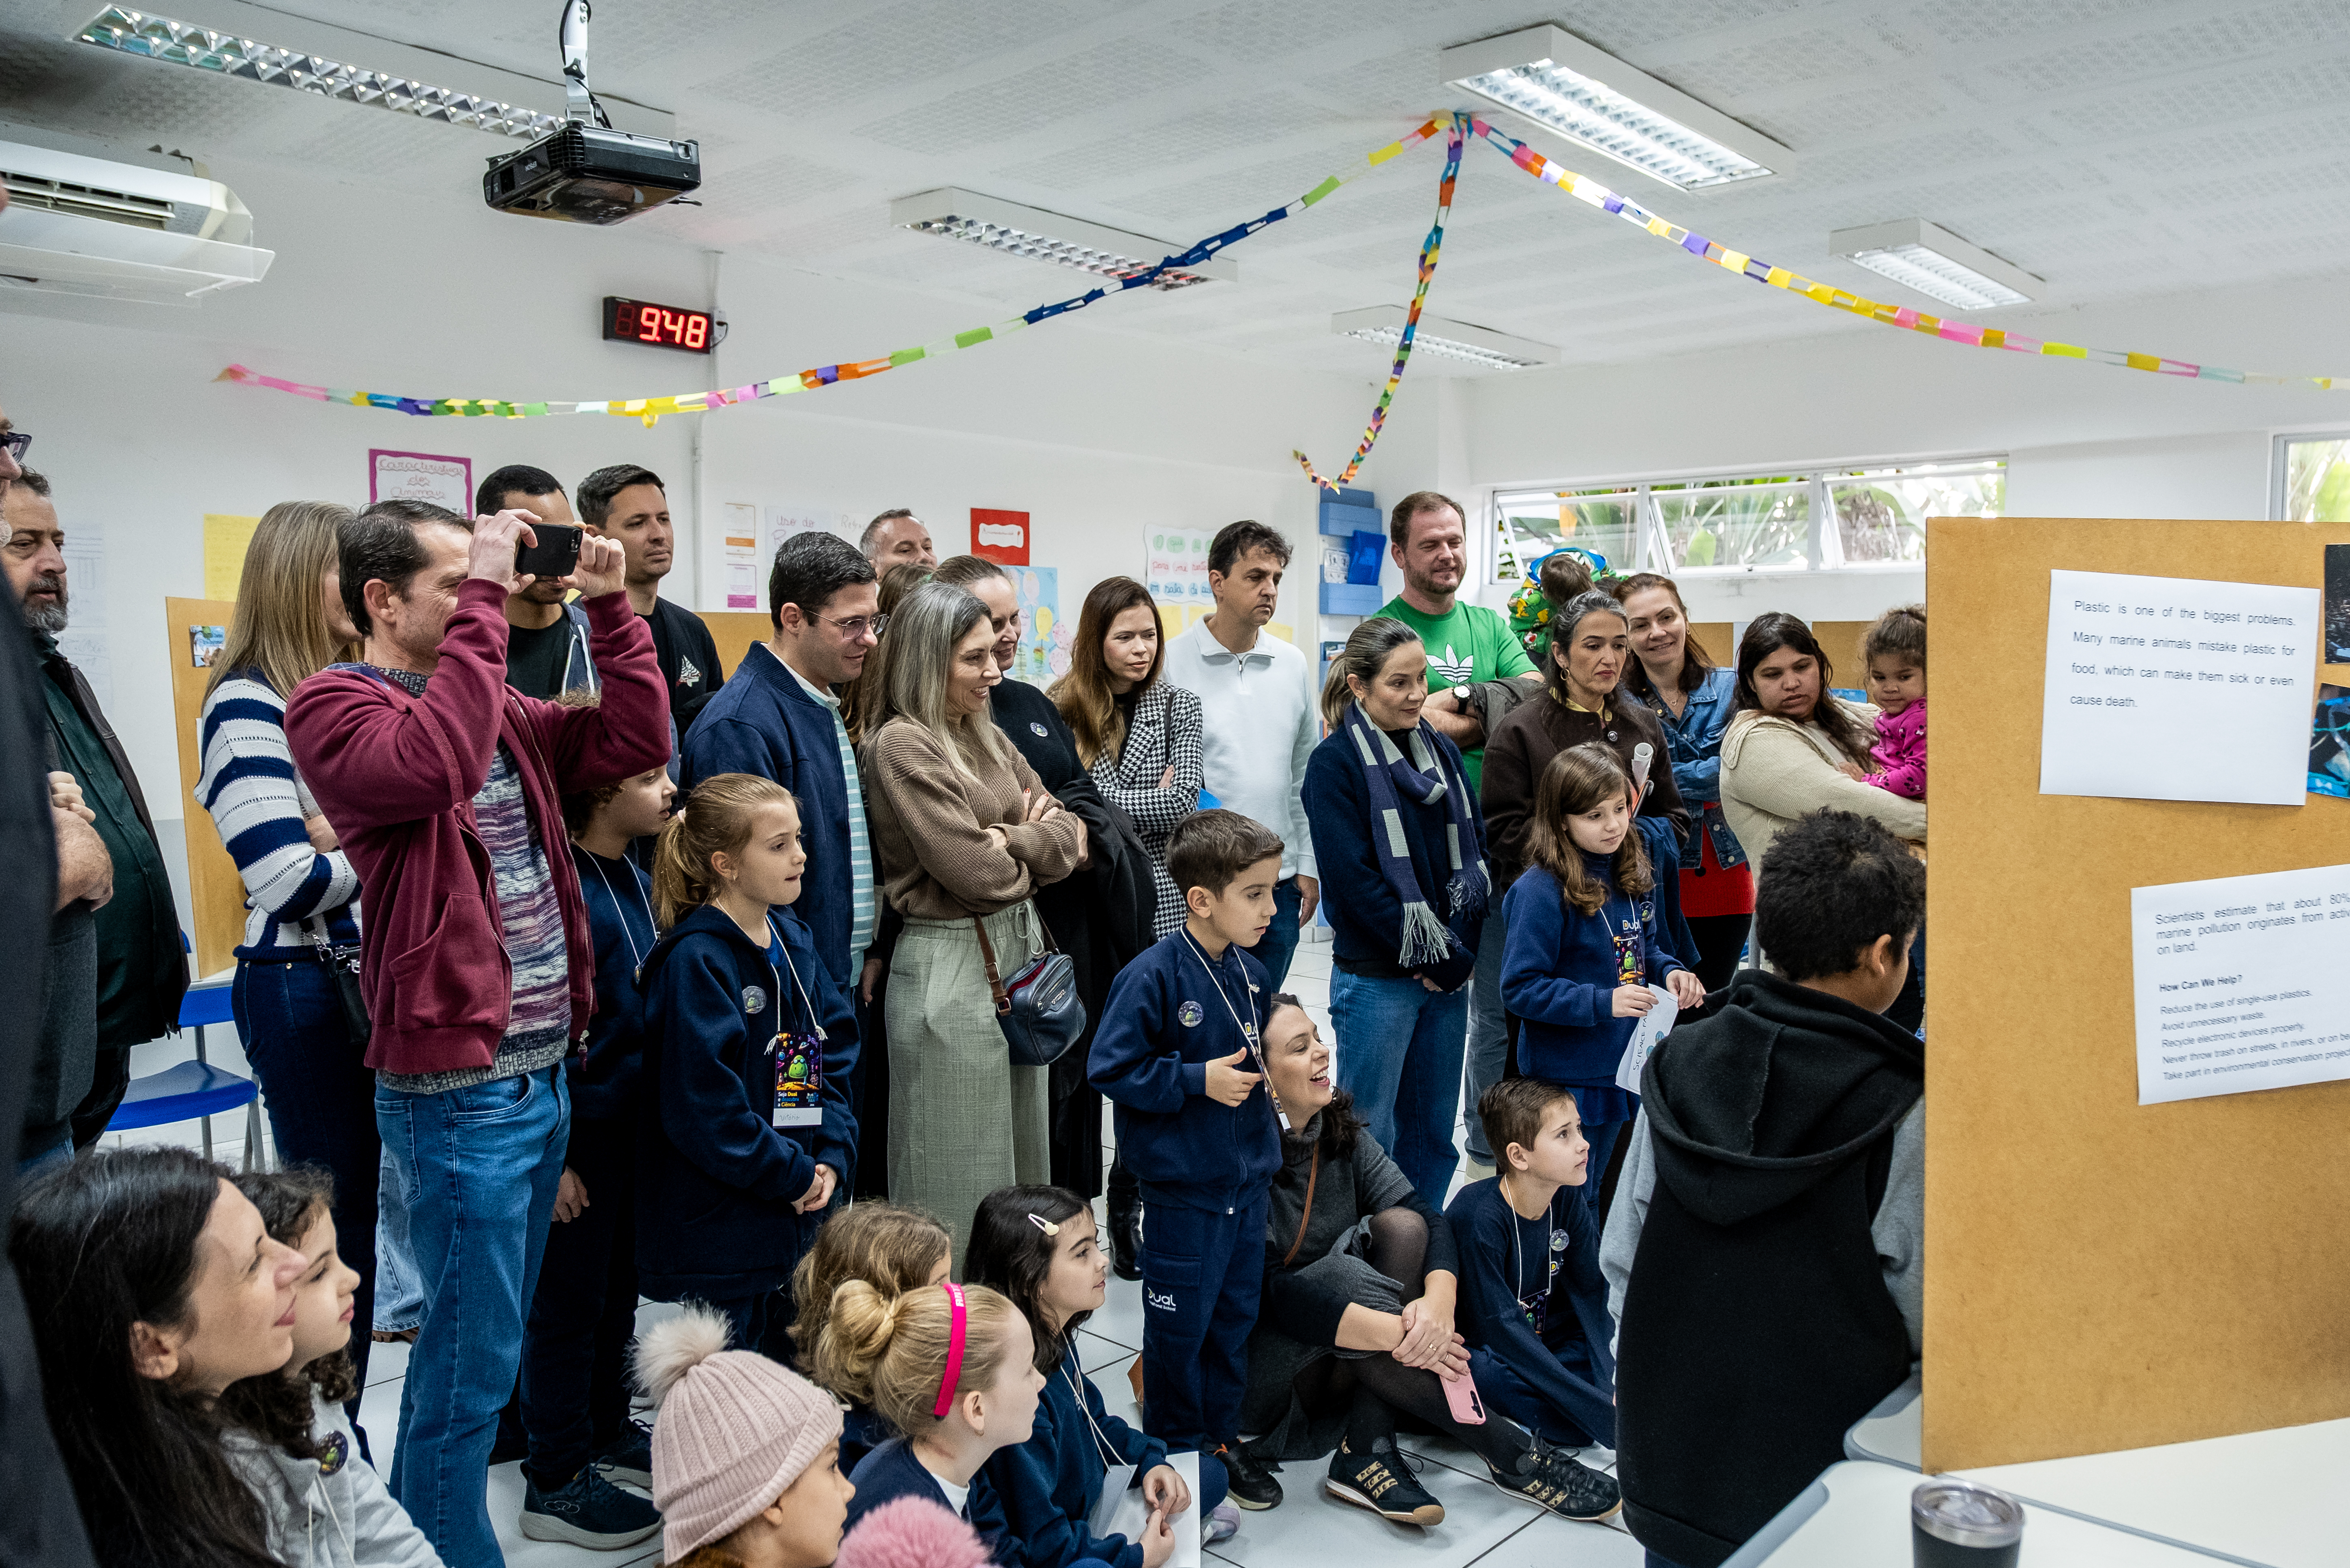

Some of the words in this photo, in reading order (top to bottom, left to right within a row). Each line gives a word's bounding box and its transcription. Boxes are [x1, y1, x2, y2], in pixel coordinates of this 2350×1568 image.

[2075, 600, 2110, 613] Plastic
[2118, 604, 2127, 614] is
[2135, 606, 2154, 616] one
[2162, 606, 2173, 617] of
[2180, 608, 2196, 619] the
[2204, 610, 2241, 624] biggest
[2247, 613, 2296, 626] problems.
[2073, 631, 2103, 646] Many
[2110, 634, 2146, 647] marine
[2152, 637, 2192, 650] animals
[2198, 640, 2237, 653] mistake
[2243, 643, 2276, 656] plastic
[2281, 645, 2296, 656] for
[2071, 663, 2098, 676] food,
[2104, 664, 2134, 677] which
[2140, 668, 2159, 678] can
[2164, 668, 2193, 681] make
[2198, 670, 2224, 682] them
[2229, 672, 2249, 684] sick
[2254, 675, 2265, 685] or
[2270, 676, 2294, 686] even
[2070, 695, 2102, 706] cause
[2105, 695, 2138, 708] death.
[2155, 911, 2205, 924] Scientists
[2214, 904, 2258, 918] estimate
[2266, 900, 2286, 912] that
[2294, 897, 2322, 908] about
[2156, 927, 2191, 940] marine
[2198, 922, 2241, 937] pollution
[2247, 916, 2296, 930] originates
[2302, 912, 2324, 923] from
[2157, 945, 2170, 955] on
[2173, 941, 2198, 953] land.
[2159, 983, 2179, 992] How
[2181, 981, 2199, 990] Can
[2200, 979, 2215, 987] We
[2217, 974, 2243, 985] Help?
[2160, 1005, 2193, 1015] Reduce
[2194, 1002, 2208, 1011] the
[2226, 998, 2236, 1007] of
[2236, 993, 2278, 1006] single-use
[2279, 989, 2313, 1001] plastics.
[2160, 1020, 2185, 1031] Avoid
[2186, 1015, 2238, 1028] unnecessary
[2240, 1012, 2267, 1021] waste.
[2161, 1037, 2195, 1048] Recycle
[2197, 1031, 2237, 1043] electronic
[2238, 1028, 2269, 1038] devices
[1633, 1032, 1645, 1070] SCIENCE
[2162, 1054, 2187, 1064] Never
[2189, 1052, 2213, 1061] throw
[2214, 1048, 2235, 1057] trash
[2237, 1047, 2248, 1055] on
[2281, 1040, 2289, 1049] in
[2163, 1071, 2184, 1081] Take
[2185, 1069, 2202, 1079] part
[2202, 1067, 2211, 1075] in
[2212, 1058, 2271, 1075] environmental
[2271, 1053, 2324, 1066] conservation
[2325, 1048, 2350, 1061] projec
